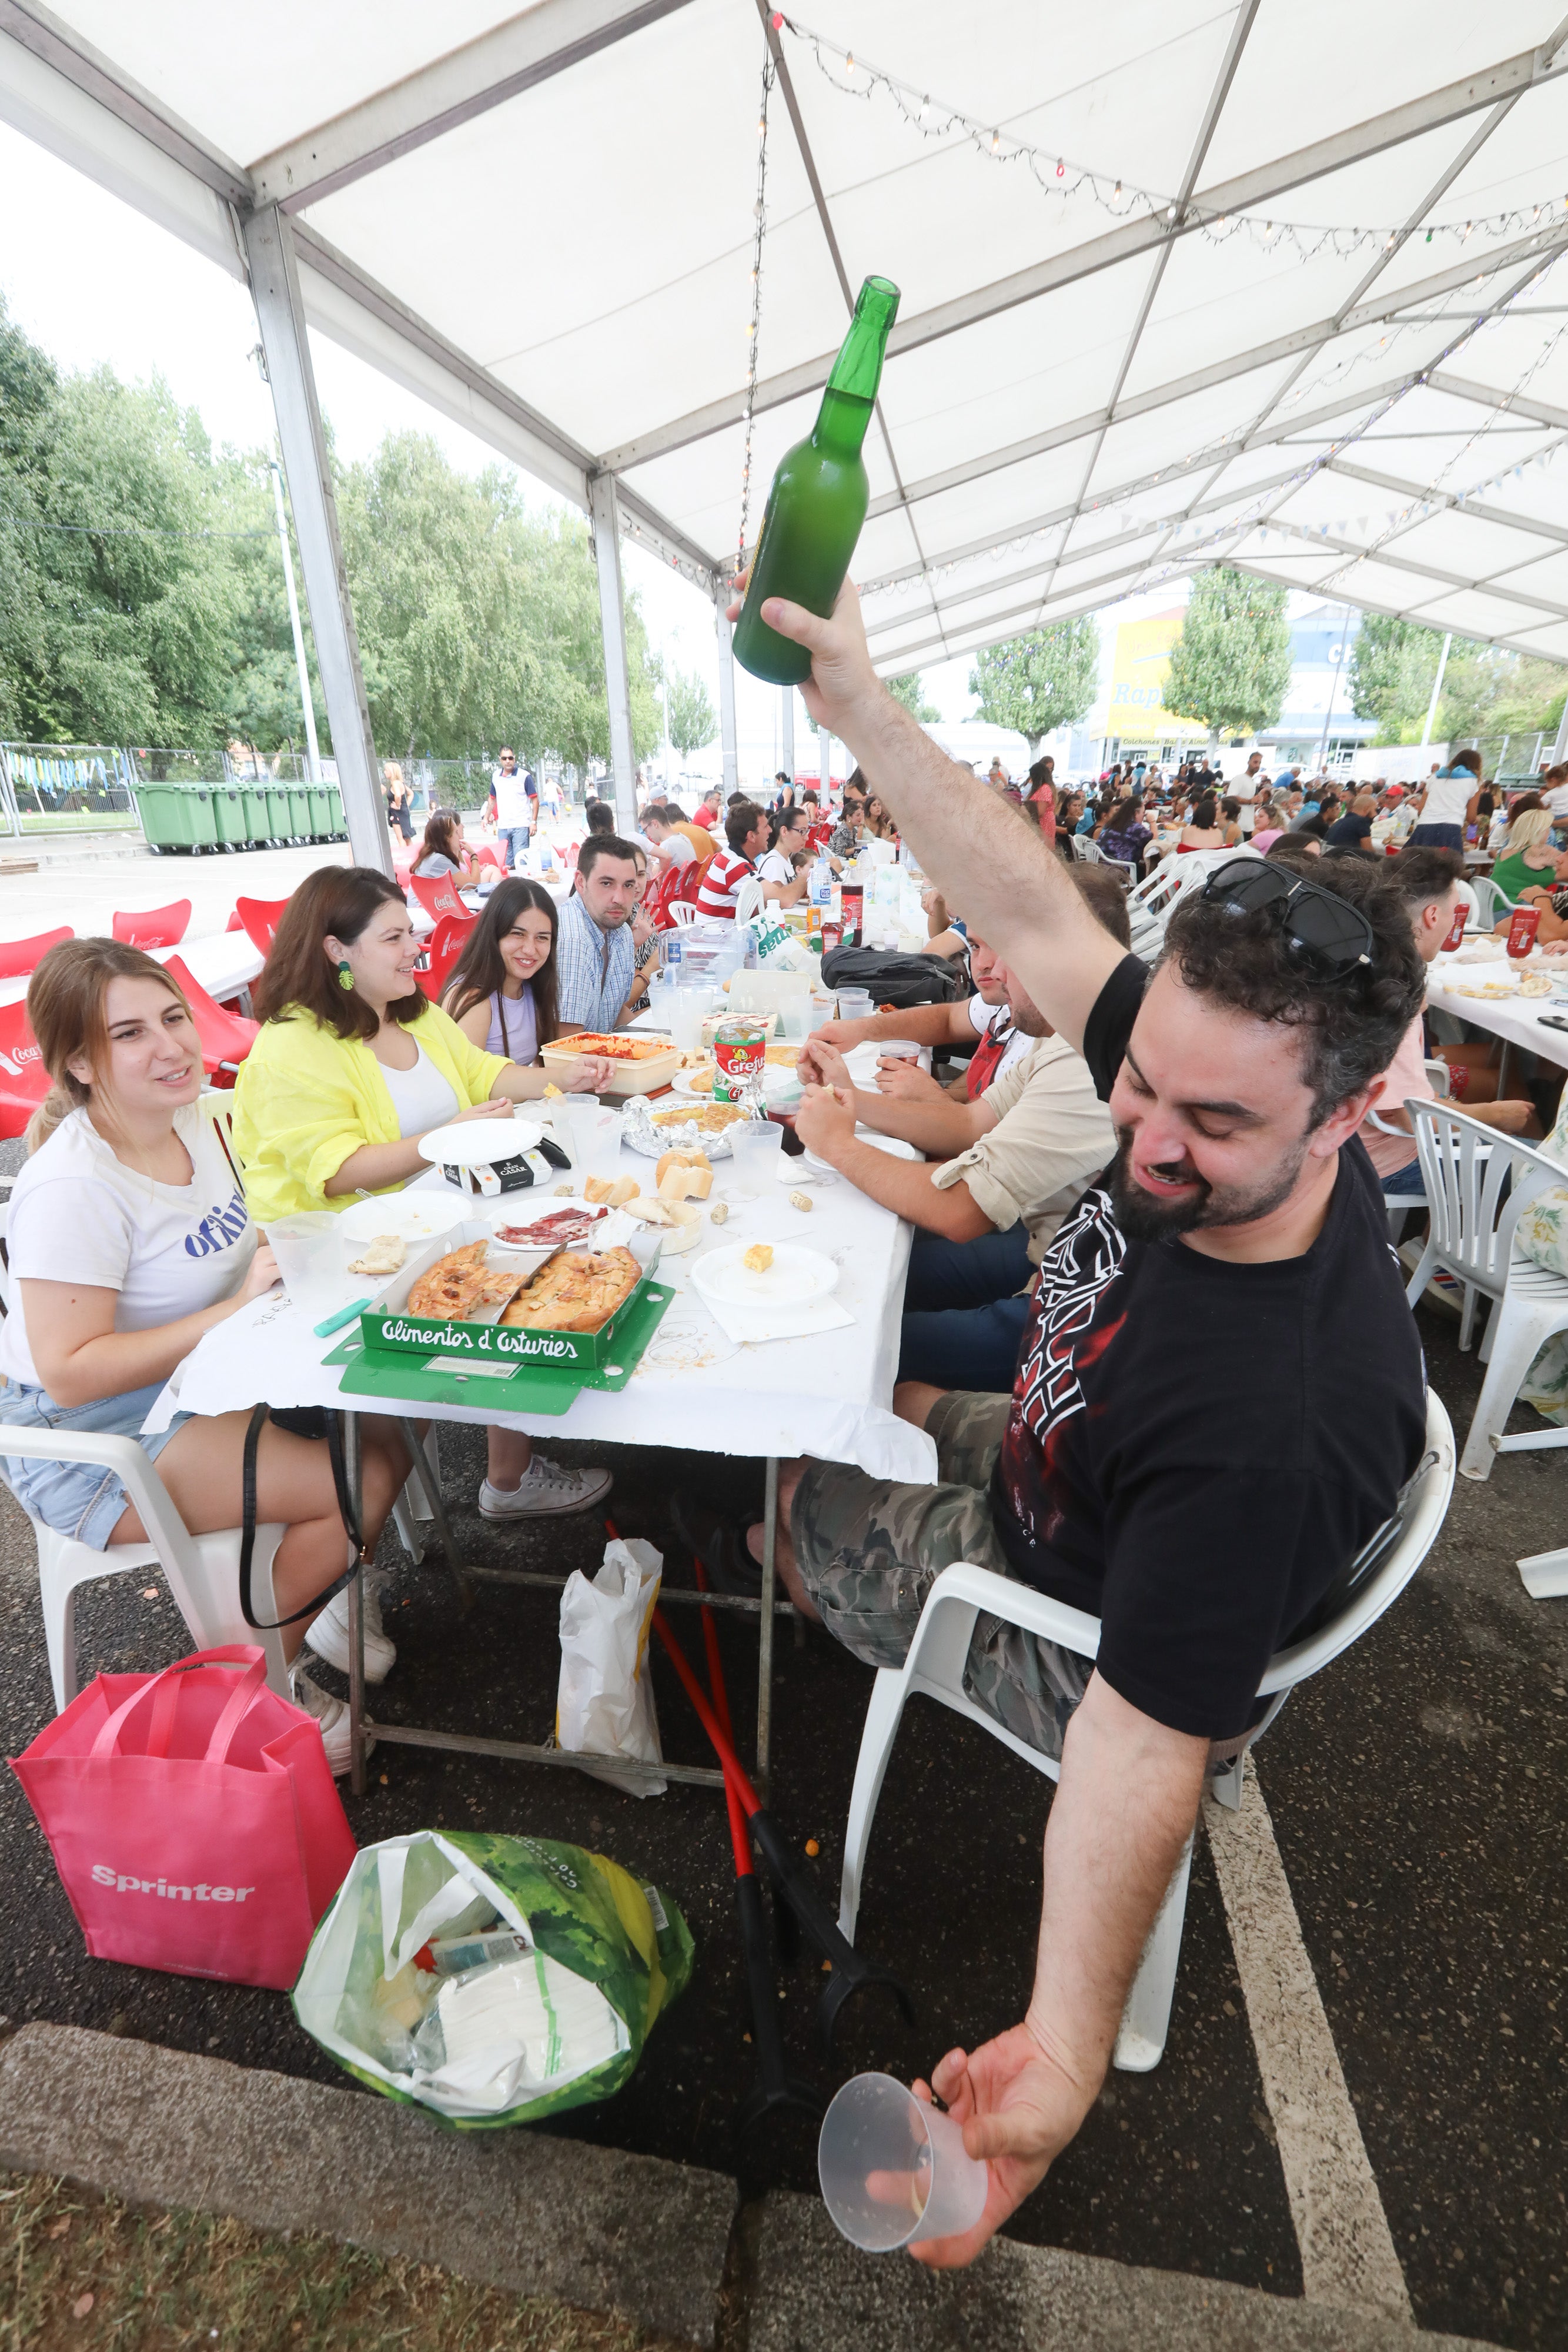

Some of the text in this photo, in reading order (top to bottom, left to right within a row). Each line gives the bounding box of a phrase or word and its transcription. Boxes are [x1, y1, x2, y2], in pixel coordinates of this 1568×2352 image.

[727, 1055, 764, 1073] Grefu
[500, 1166, 528, 1175] CASAR
[91, 1864, 256, 1903] Sprinter
